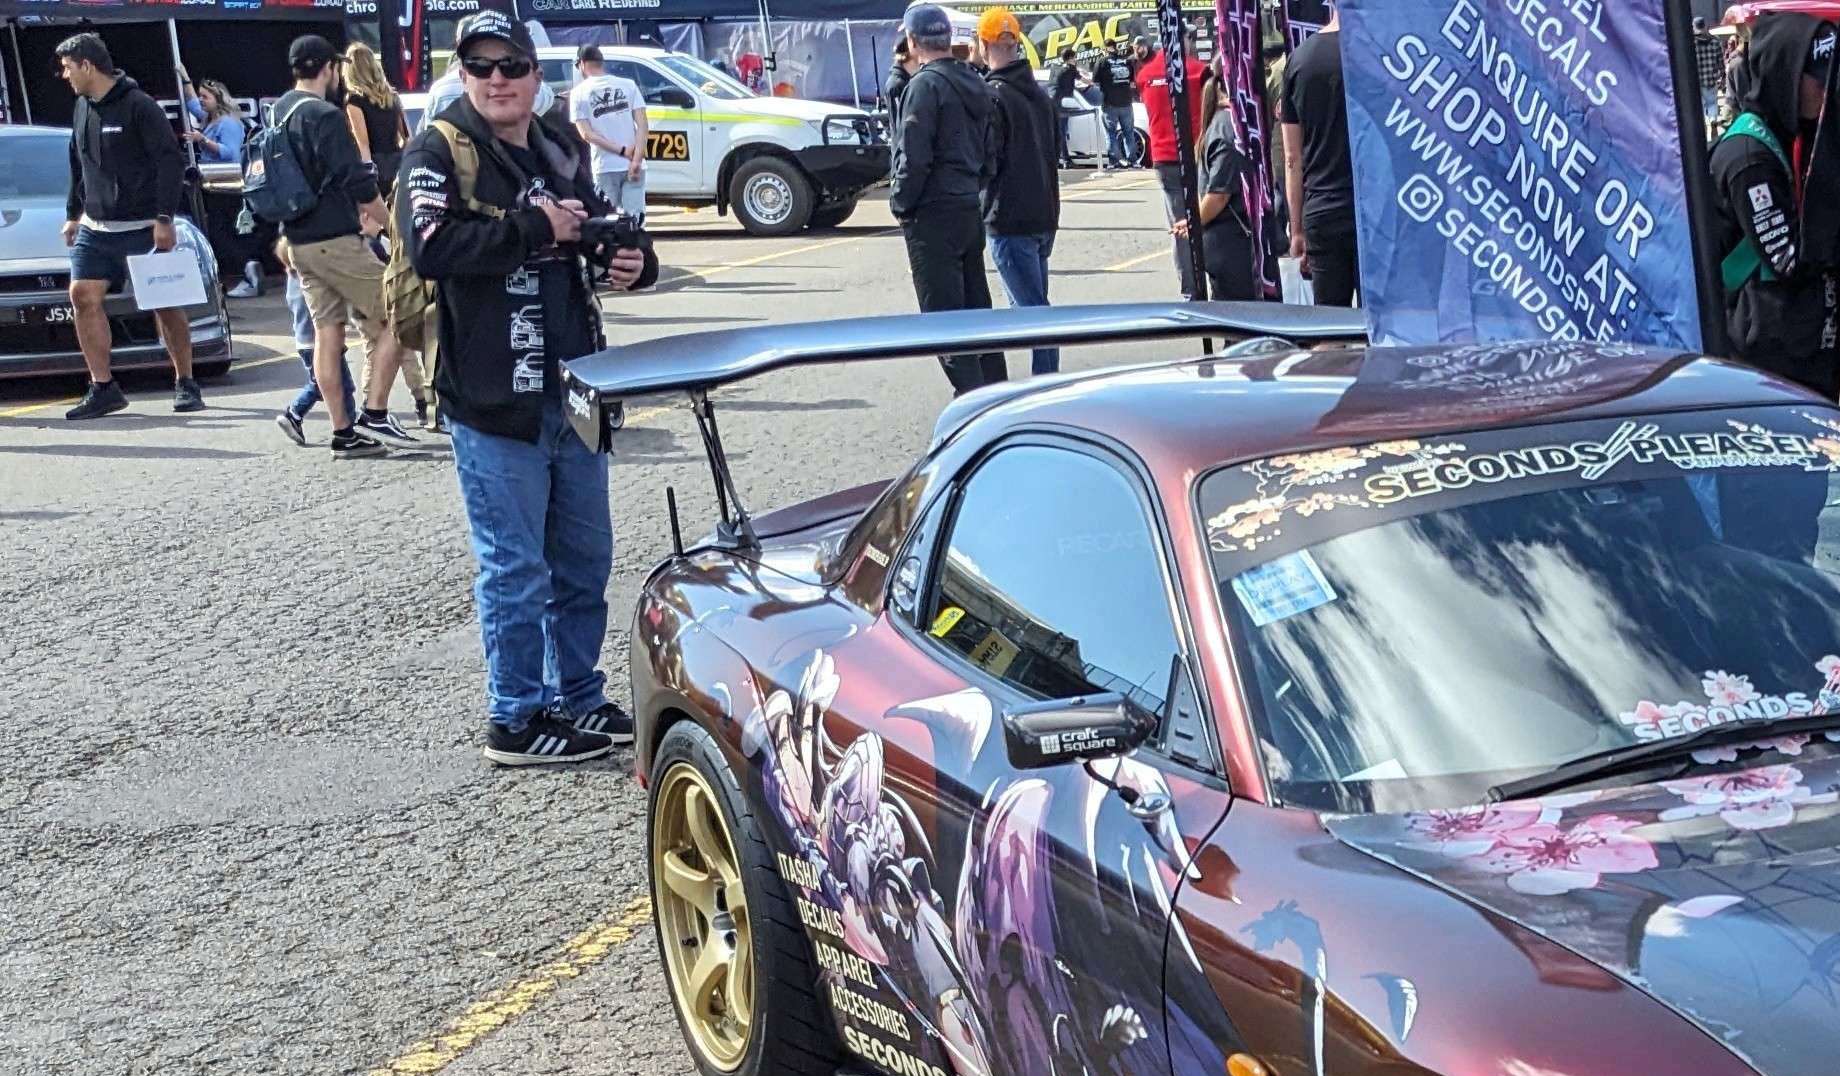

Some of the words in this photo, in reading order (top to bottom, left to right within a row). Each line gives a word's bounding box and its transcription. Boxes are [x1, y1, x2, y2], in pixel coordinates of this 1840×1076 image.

[1045, 12, 1133, 60] PAC
[644, 134, 688, 159] 729
[1441, 0, 1597, 194] ENQUIRE
[1595, 179, 1655, 259] OR
[1381, 34, 1506, 149] SHOP
[1505, 143, 1586, 258] NOW
[1583, 253, 1638, 329] AT:
[1363, 440, 1609, 505] SECONDS
[1061, 727, 1100, 743] craft
[1634, 690, 1814, 743] SECONDS
[1062, 737, 1116, 753] square
[776, 851, 822, 893] ITASHA
[796, 896, 846, 939] DECALS
[813, 939, 878, 990] APPAREL
[829, 983, 912, 1042] ACCESSORIES
